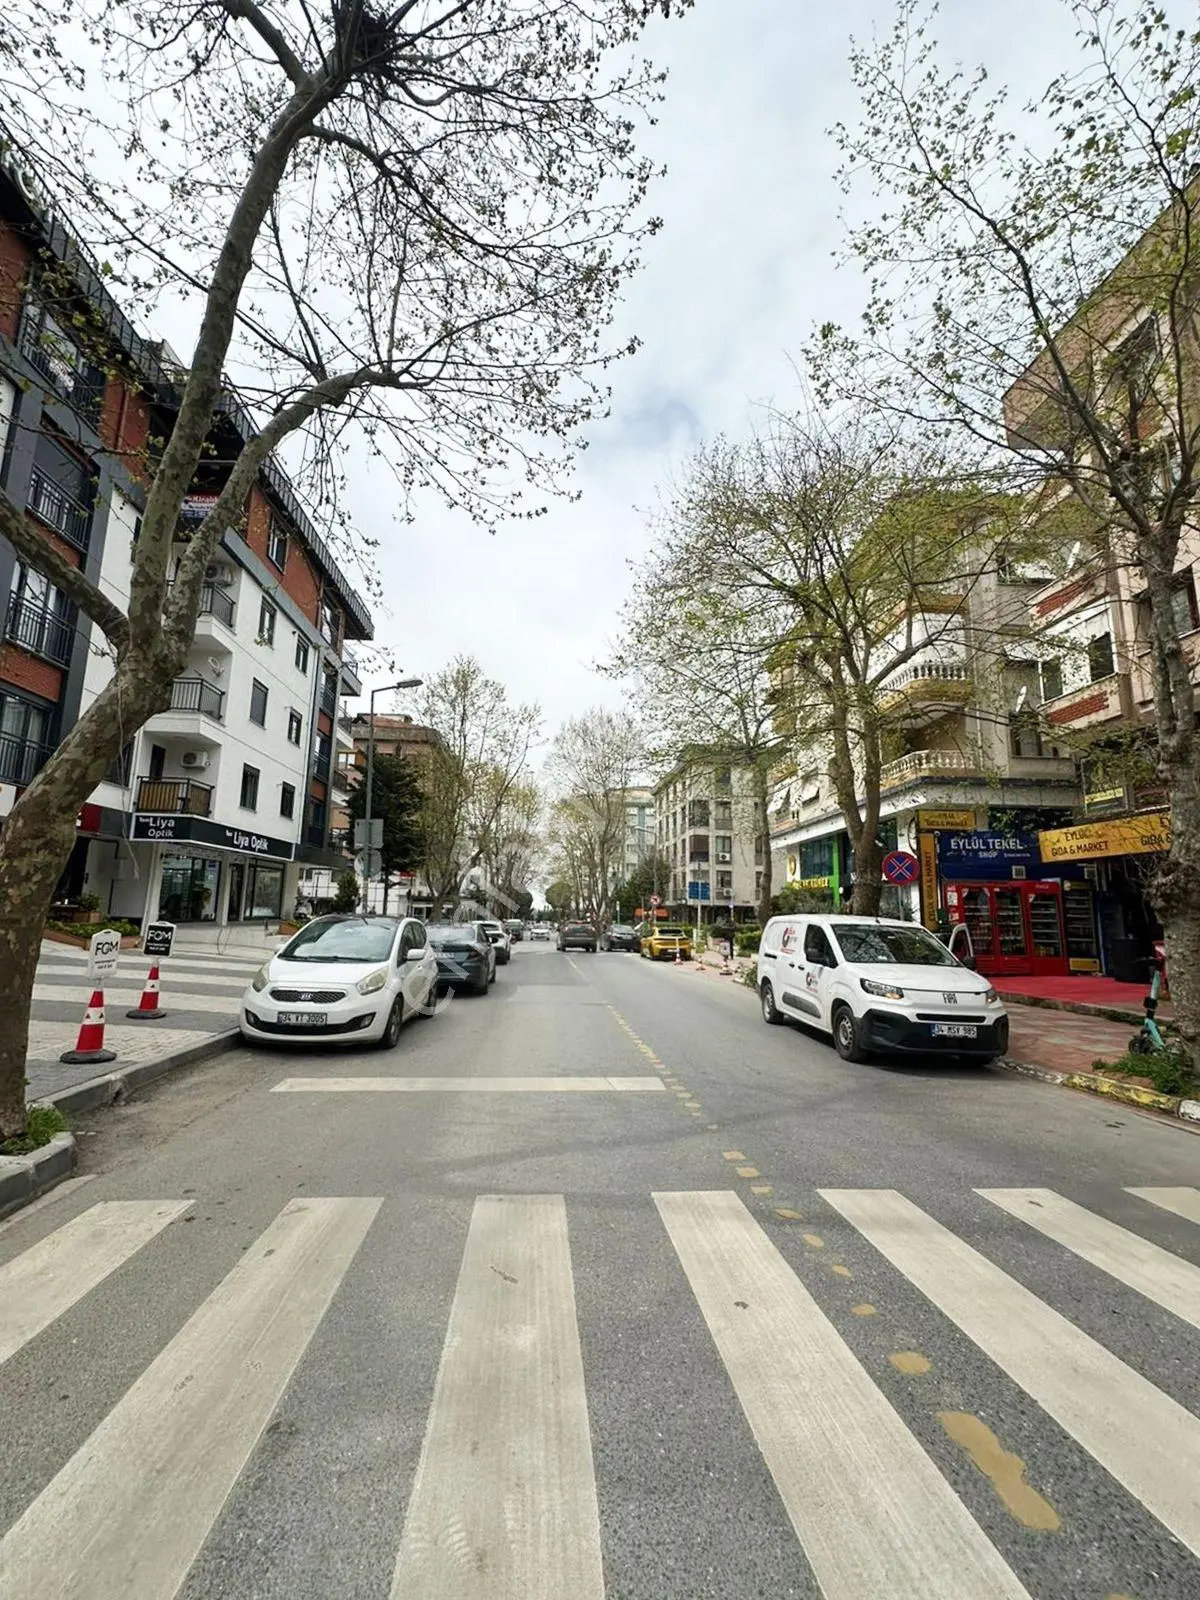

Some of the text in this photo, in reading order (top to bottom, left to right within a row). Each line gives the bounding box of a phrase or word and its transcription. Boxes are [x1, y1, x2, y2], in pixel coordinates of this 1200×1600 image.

[150, 817, 175, 828] Liya
[148, 829, 174, 838] Optik
[233, 832, 249, 848] Liya
[251, 836, 269, 851] Optik
[950, 836, 1024, 849] EYLÜL TEKEL
[1077, 841, 1108, 853] MARKET
